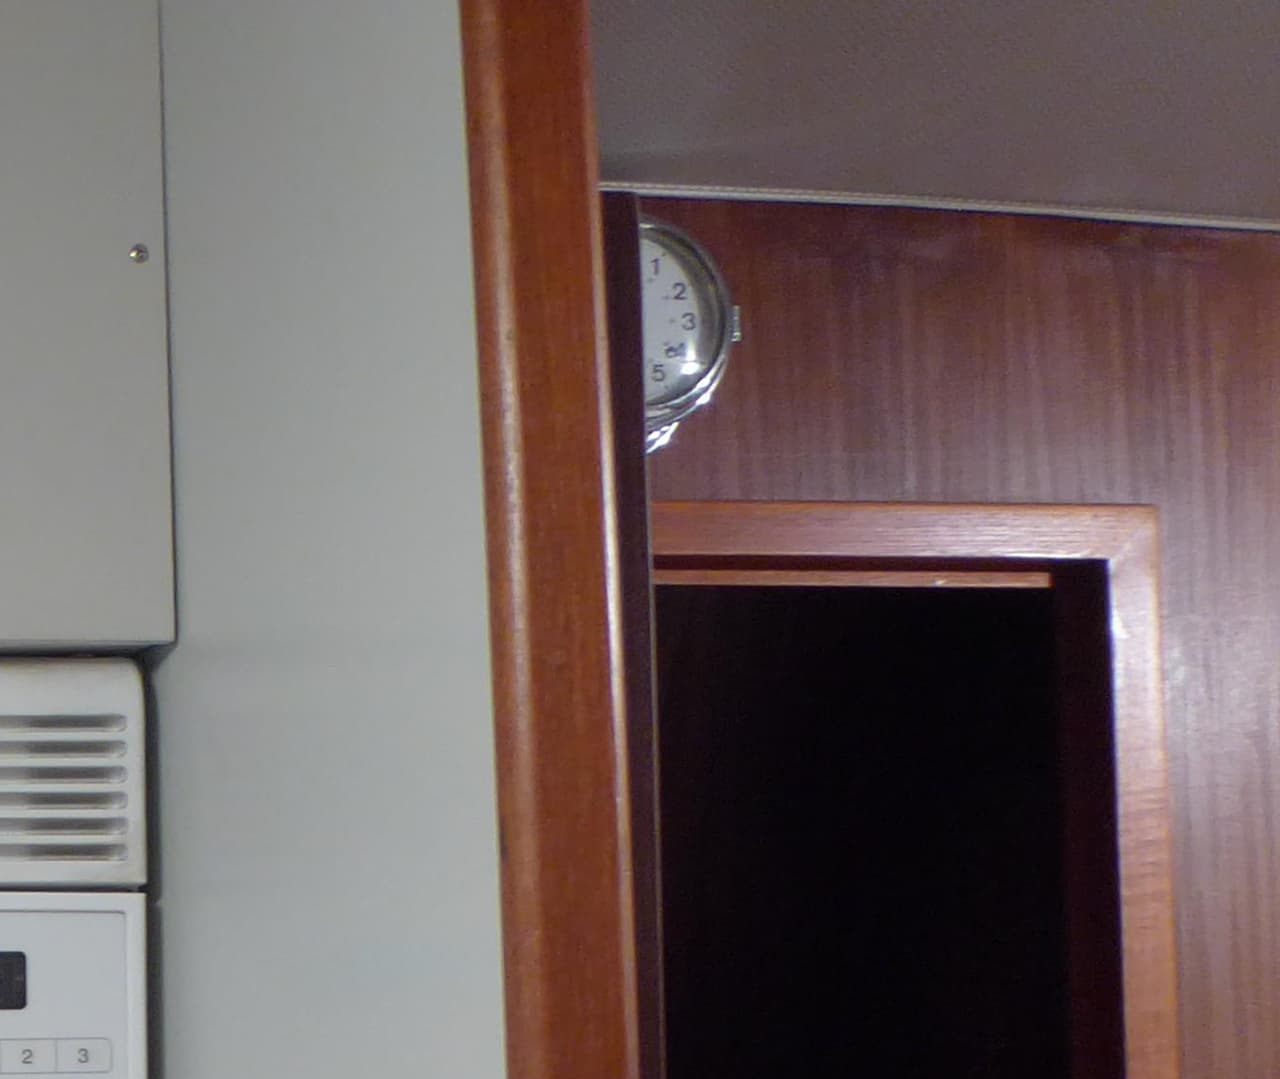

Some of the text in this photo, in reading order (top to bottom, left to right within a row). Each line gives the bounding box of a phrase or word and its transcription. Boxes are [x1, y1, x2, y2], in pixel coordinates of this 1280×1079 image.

[650, 258, 660, 275] 1
[672, 283, 686, 299] 2
[682, 313, 696, 330] 3
[652, 365, 665, 381] 5
[22, 1049, 33, 1064] 2
[77, 1048, 89, 1063] 3
